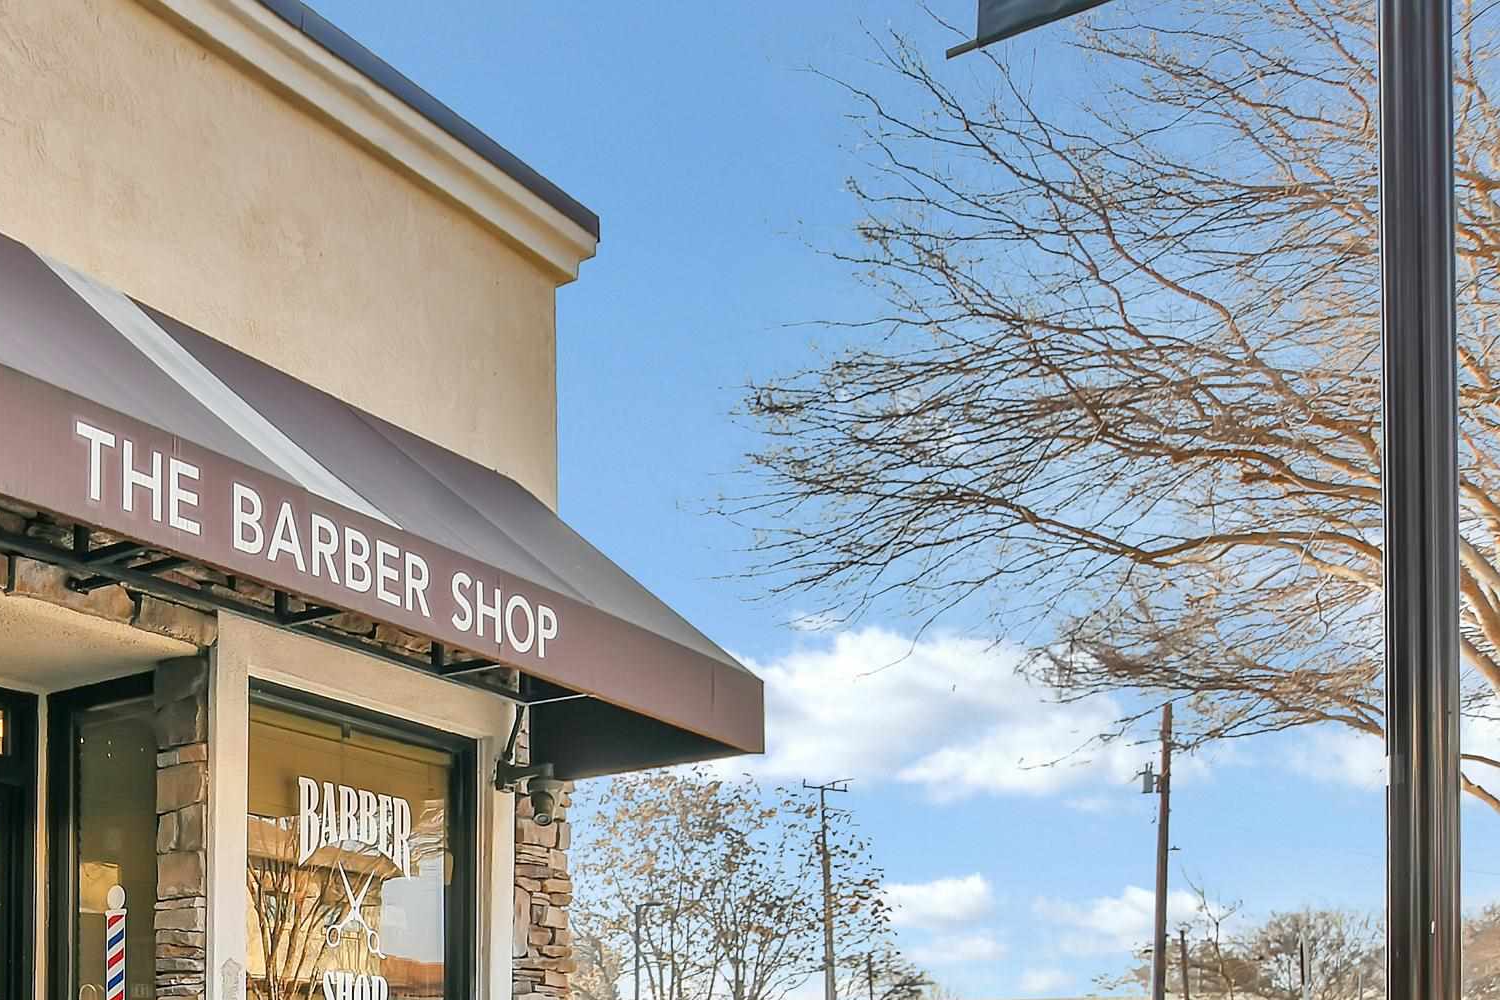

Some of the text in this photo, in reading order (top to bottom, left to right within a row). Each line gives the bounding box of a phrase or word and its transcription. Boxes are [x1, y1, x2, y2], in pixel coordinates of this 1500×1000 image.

[75, 420, 559, 658] THE BARBER SHOP
[297, 775, 413, 880] BARBER
